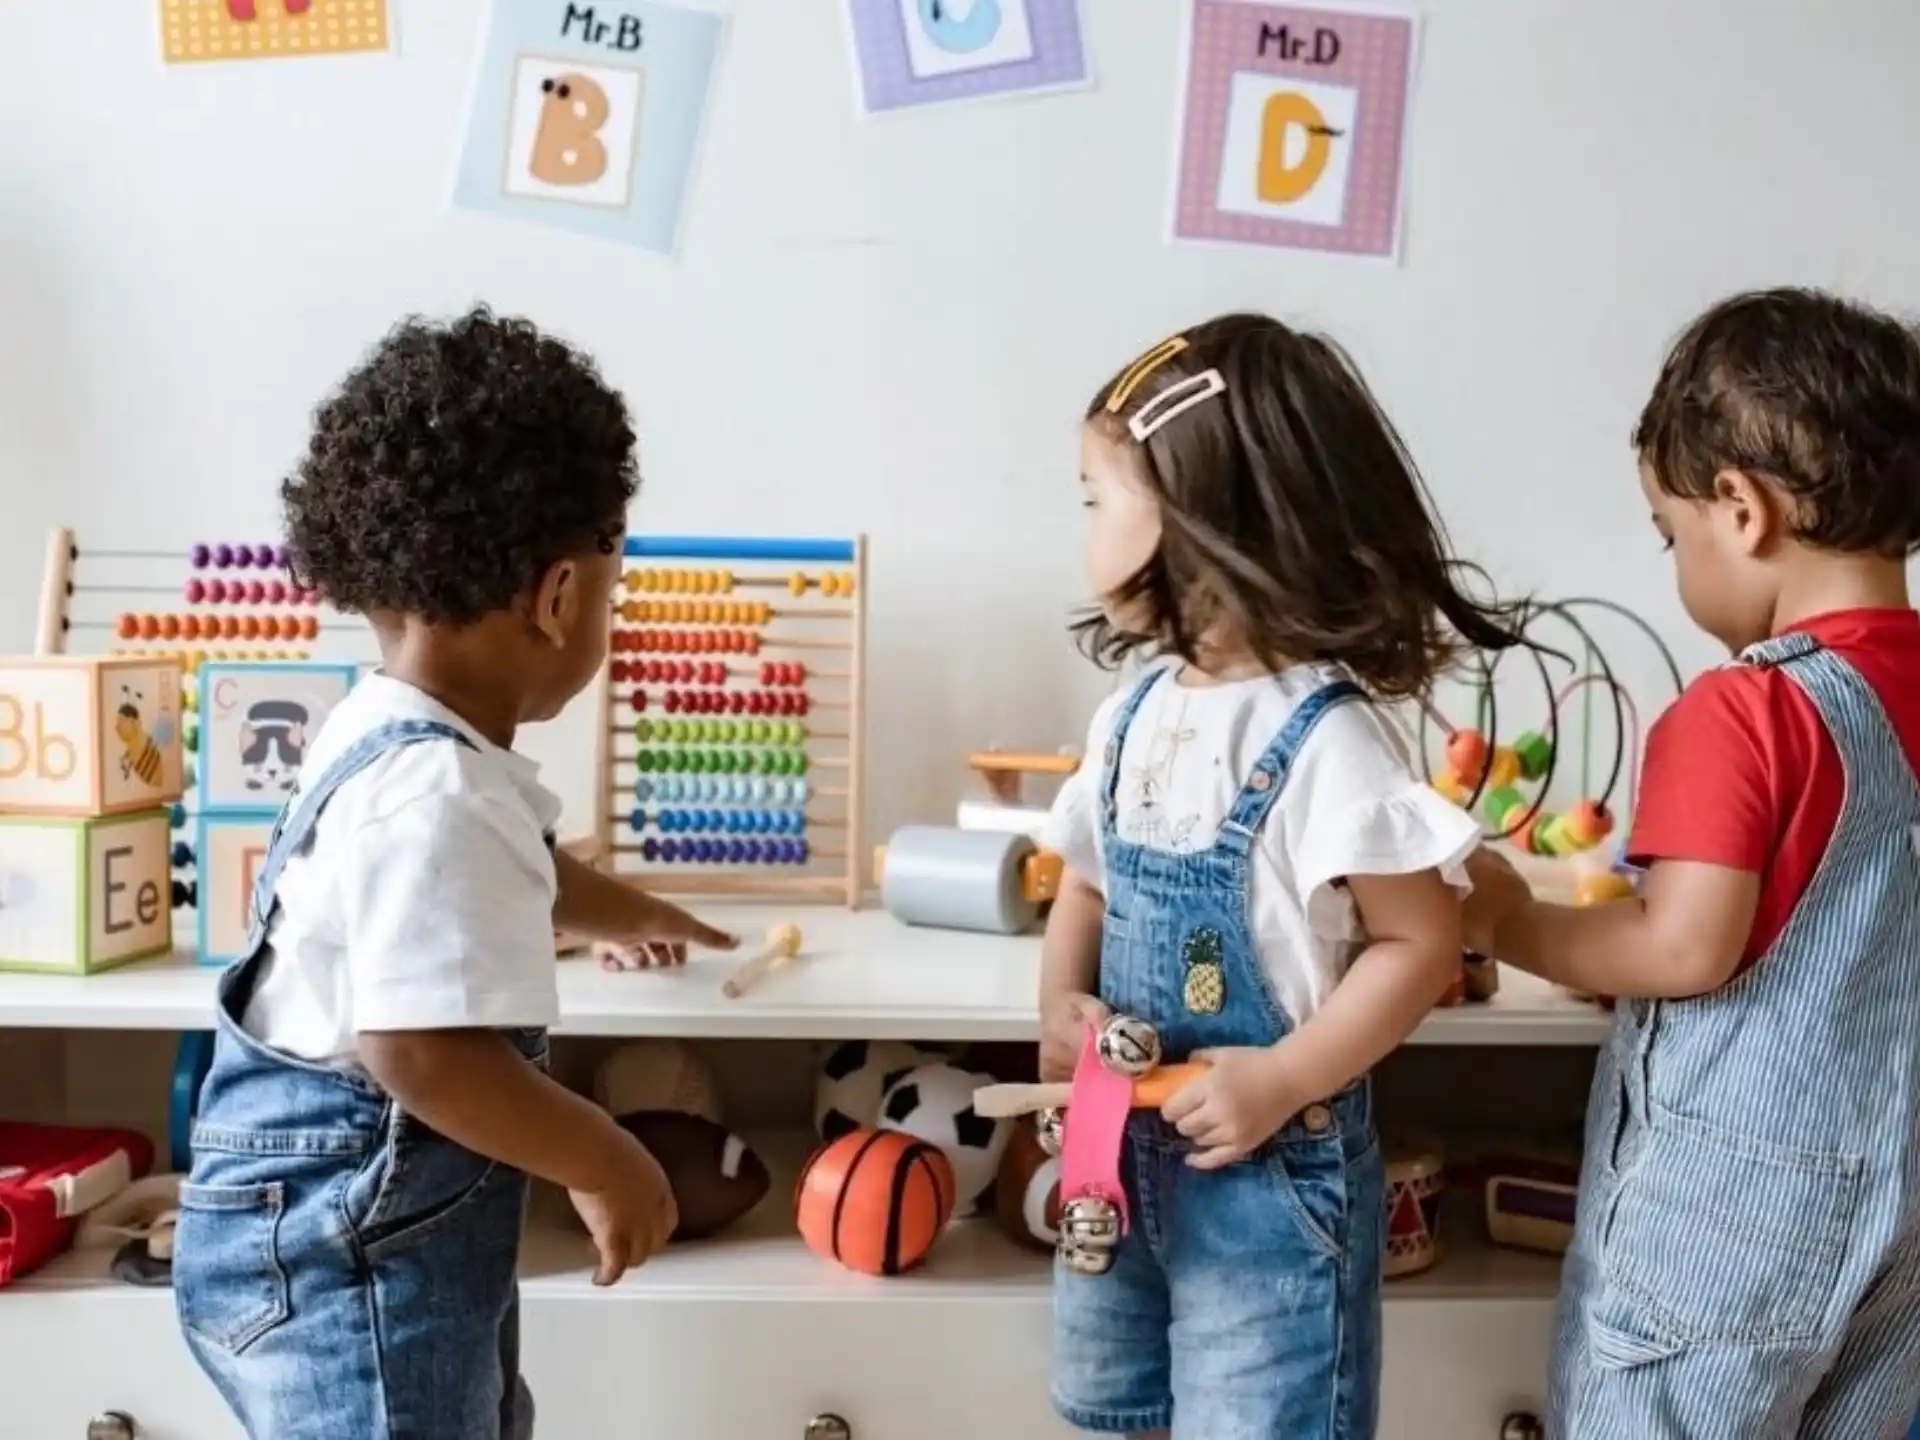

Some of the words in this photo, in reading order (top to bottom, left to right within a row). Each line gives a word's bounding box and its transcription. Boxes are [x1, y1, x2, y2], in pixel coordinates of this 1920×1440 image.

[560, 1, 642, 51] Mr.B
[1257, 20, 1342, 65] Mr.D
[528, 71, 609, 186] B
[1256, 89, 1330, 206] D
[214, 678, 238, 711] C
[104, 846, 160, 934] Ee
